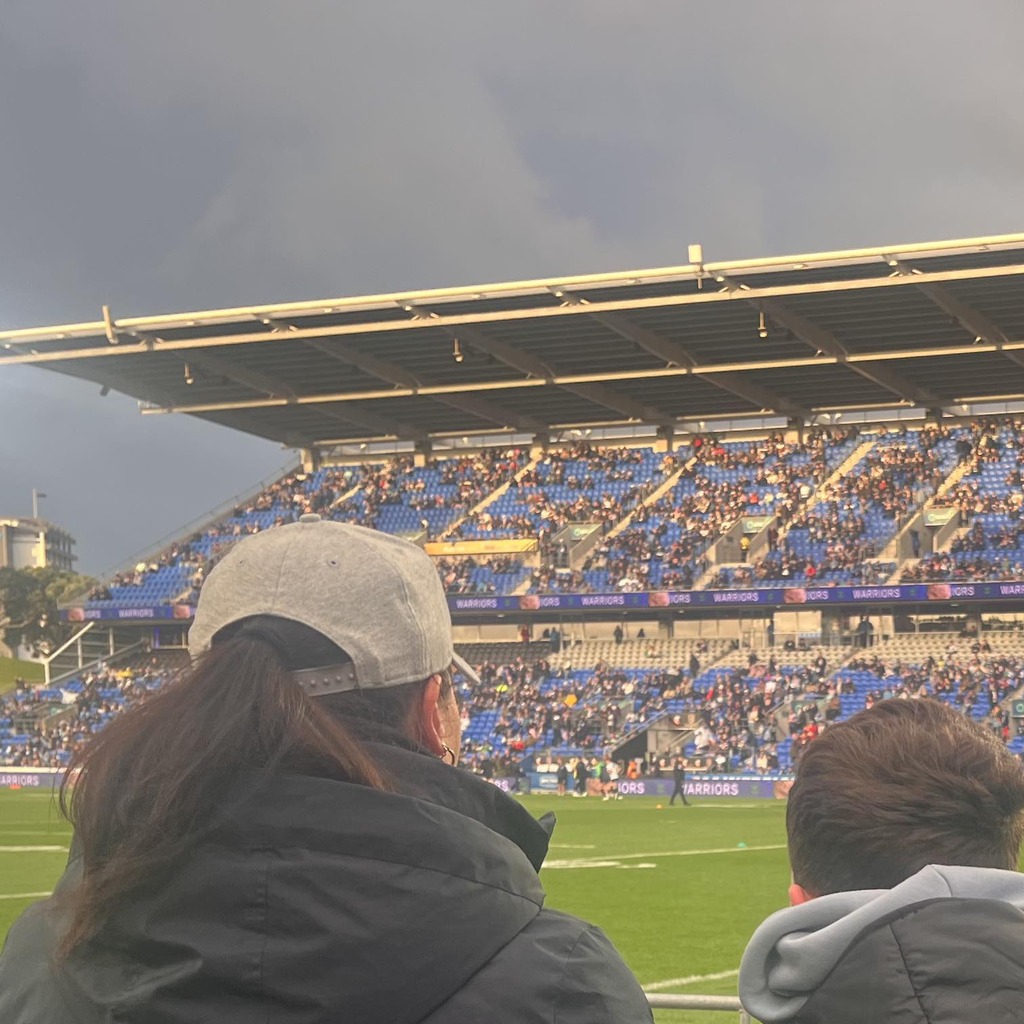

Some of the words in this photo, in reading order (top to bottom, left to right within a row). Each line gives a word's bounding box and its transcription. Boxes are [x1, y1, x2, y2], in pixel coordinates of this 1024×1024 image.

[806, 590, 828, 600] IORS
[852, 588, 901, 599] WARRIORS
[952, 586, 975, 596] IORS
[540, 597, 560, 607] IORS
[581, 595, 624, 607] WARRIORS
[670, 594, 691, 604] IORS
[713, 592, 760, 603] WARRIORS
[456, 598, 497, 609] WARRIORS
[118, 609, 154, 619] WARRIORS
[0, 776, 39, 787] ARRIORS
[618, 782, 645, 795] IORS
